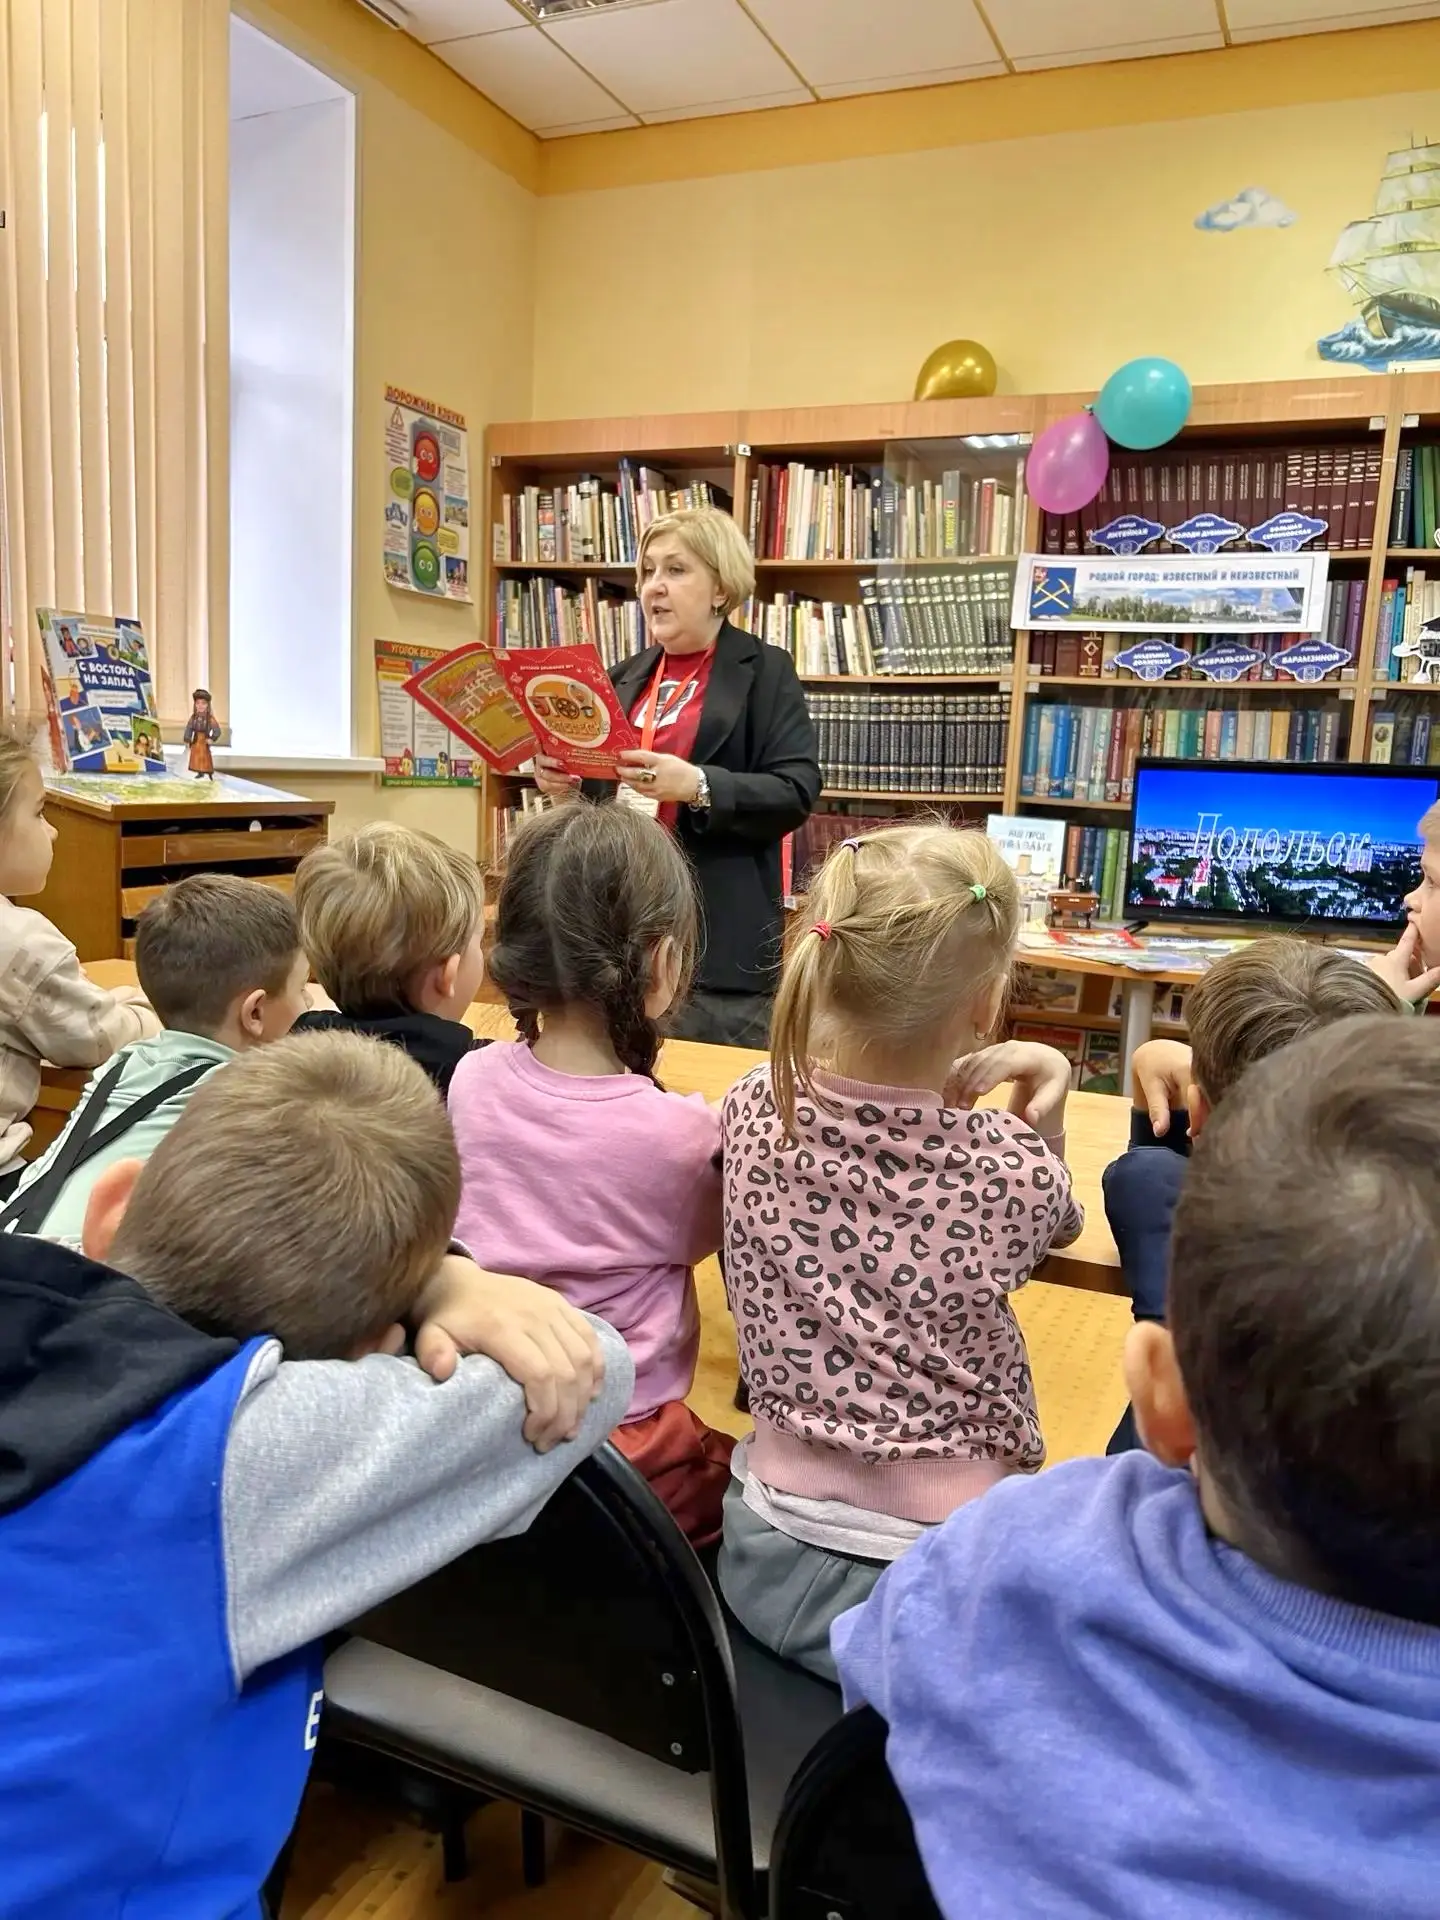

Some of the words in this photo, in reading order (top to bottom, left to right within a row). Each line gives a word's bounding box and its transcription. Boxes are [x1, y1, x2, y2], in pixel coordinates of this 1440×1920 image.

[1107, 528, 1148, 539] ЛИТЕЙНАЯ
[1089, 571, 1125, 581] РОДНОЙ
[1128, 572, 1160, 583] ГОРОД:
[1162, 569, 1218, 582] ИЗВЕСТНЫЙ
[1220, 571, 1228, 581] И
[1229, 568, 1300, 581] НЕИЗВЕСТНЫЙ
[391, 643, 419, 657] УГОЛОК
[1198, 654, 1256, 666] ФЕВРАЛЬСКАЯ
[79, 661, 87, 671] С
[90, 662, 136, 677] ВОСТОКА
[83, 673, 99, 684] НА
[101, 676, 136, 688] ЗАПАД
[1193, 812, 1372, 873] Подольск
